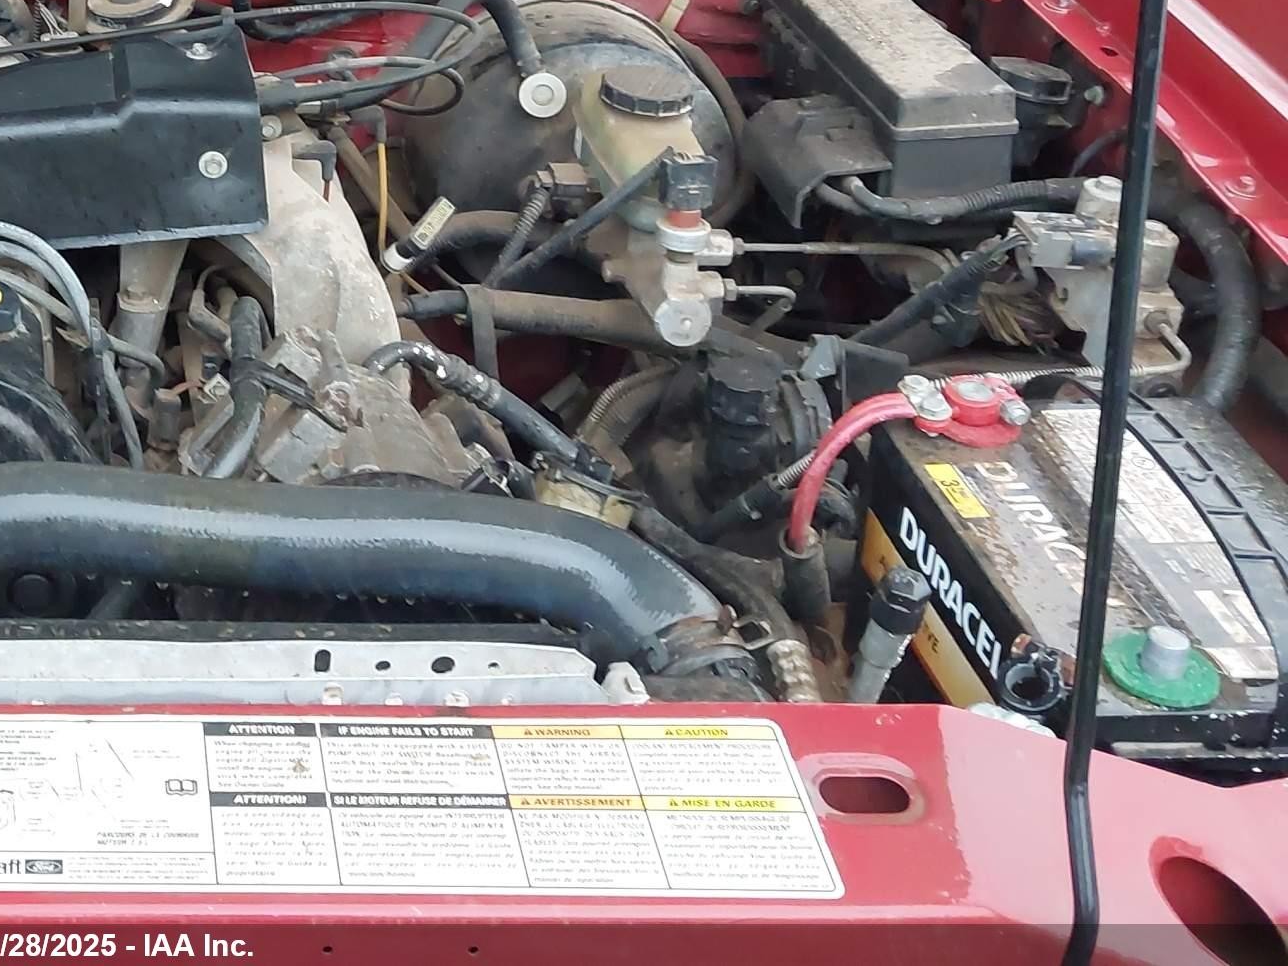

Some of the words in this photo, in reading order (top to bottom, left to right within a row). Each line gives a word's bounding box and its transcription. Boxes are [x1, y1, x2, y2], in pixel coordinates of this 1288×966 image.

[899, 507, 1003, 679] DURACEL
[229, 725, 295, 734] ATTENTION
[338, 726, 348, 735] IF
[350, 727, 390, 735] ENGINE
[392, 727, 421, 736] FAILS
[423, 728, 438, 736] TO
[440, 728, 473, 736] START
[534, 728, 591, 736] WARNING
[233, 795, 307, 804] ATTENTION!
[345, 796, 357, 805] LE
[358, 796, 399, 805] MOTEUR
[400, 796, 437, 805] REFUSE
[438, 796, 452, 805] DE
[534, 798, 633, 806] AVERTISSEMENT
[681, 799, 713, 807] MISE
[734, 800, 776, 808] GARDE
